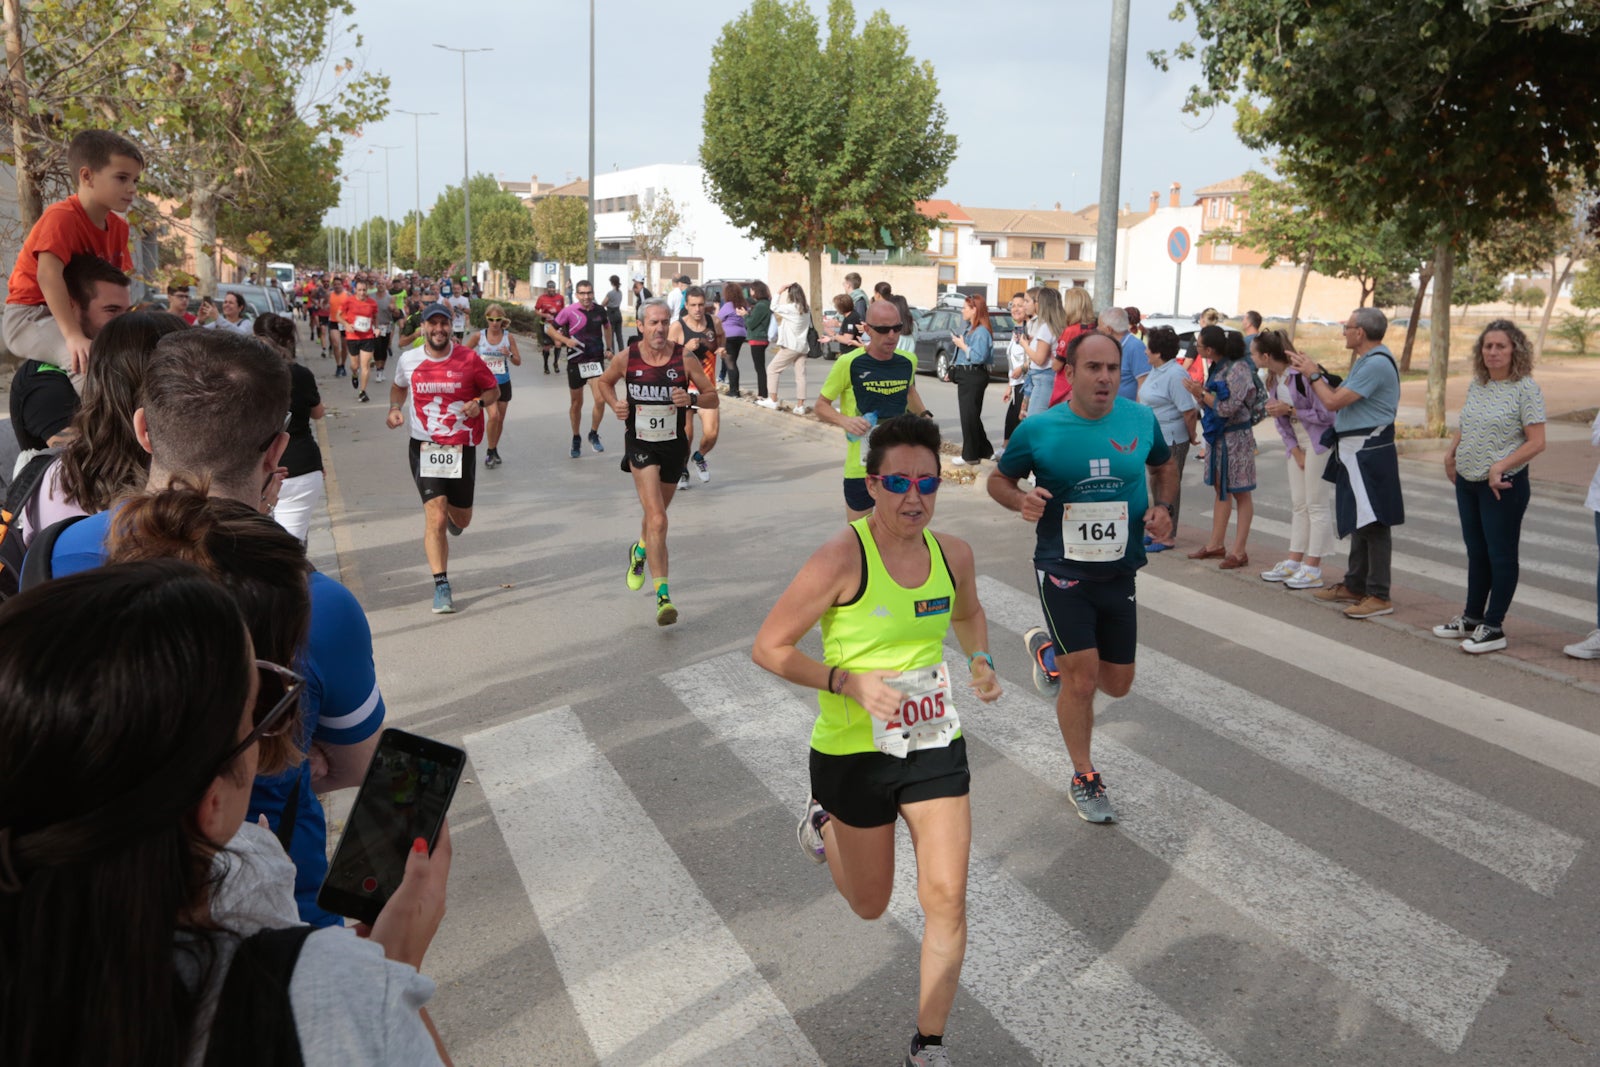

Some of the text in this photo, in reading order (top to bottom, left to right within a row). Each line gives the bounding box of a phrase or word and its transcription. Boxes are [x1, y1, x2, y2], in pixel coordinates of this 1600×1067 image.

[582, 364, 598, 372] 3103
[649, 418, 665, 429] 91
[429, 453, 454, 464] 608
[1078, 522, 1117, 541] 164
